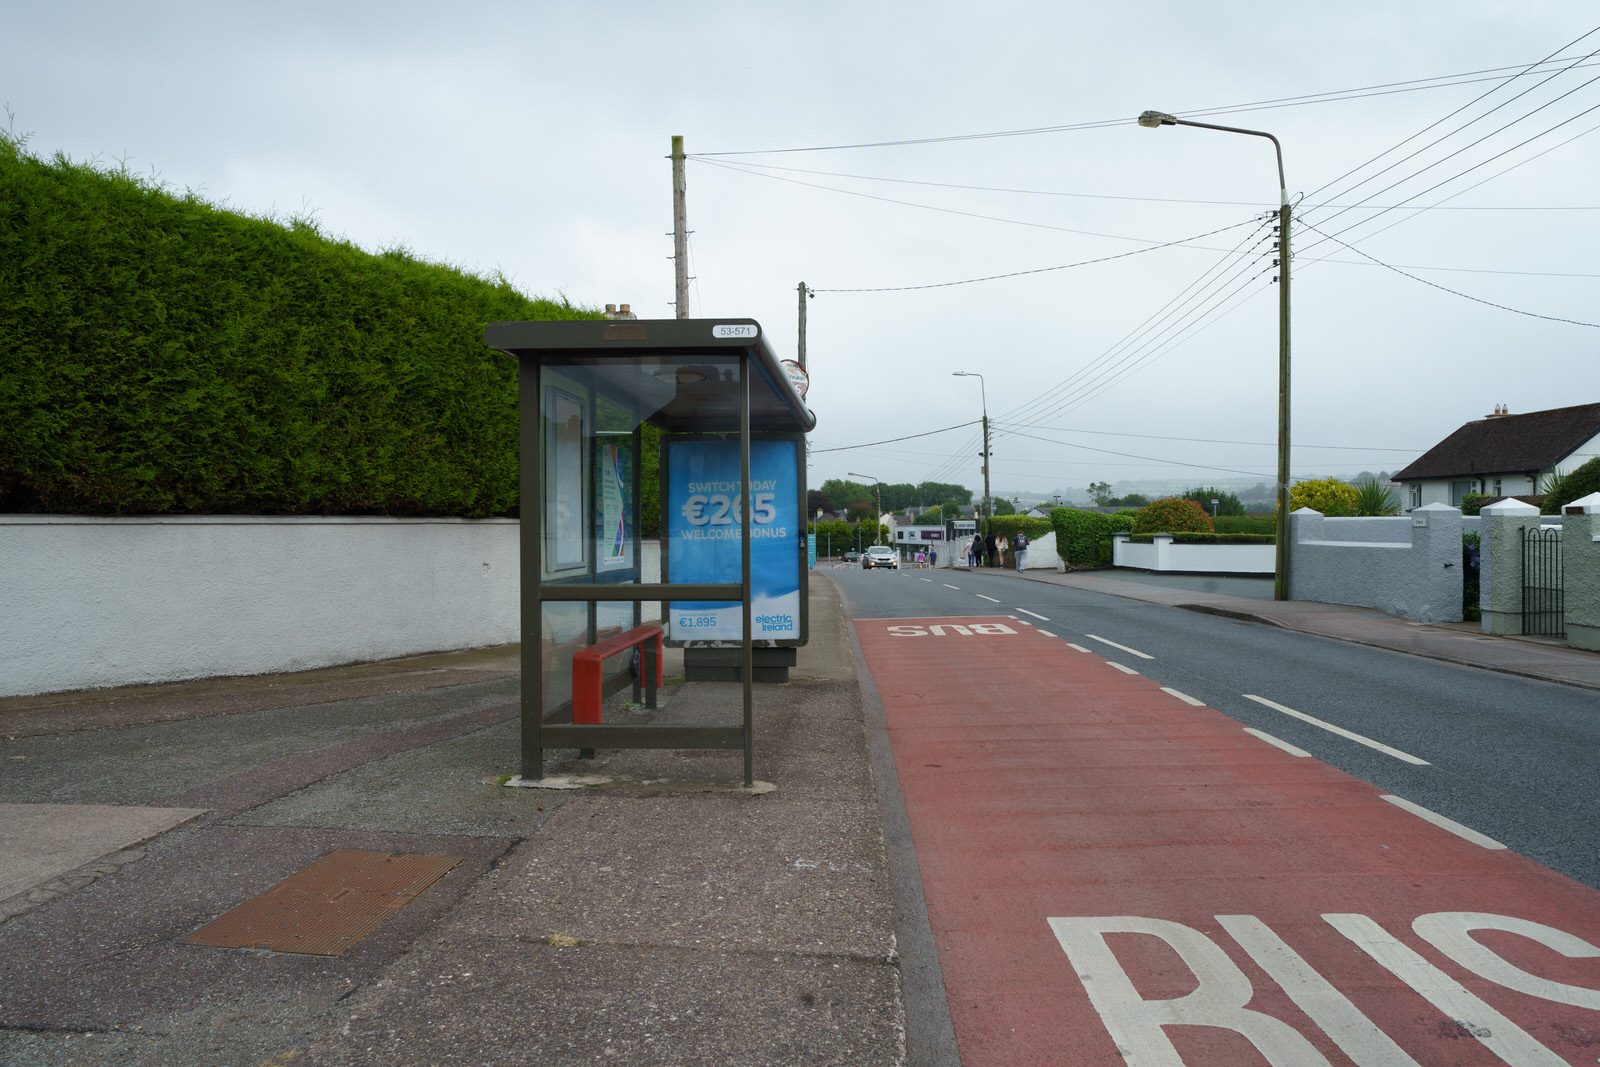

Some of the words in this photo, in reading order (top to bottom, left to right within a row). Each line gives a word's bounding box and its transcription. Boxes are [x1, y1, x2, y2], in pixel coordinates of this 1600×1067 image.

[721, 327, 751, 335] 53-571
[688, 482, 735, 493] SWITCH
[682, 493, 776, 526] €265
[681, 529, 741, 540] WELCOME
[750, 527, 786, 538] ONUS
[679, 617, 717, 628] €1,895
[755, 613, 792, 623] electric
[762, 622, 793, 631] Ireland
[887, 623, 1018, 637] BUS
